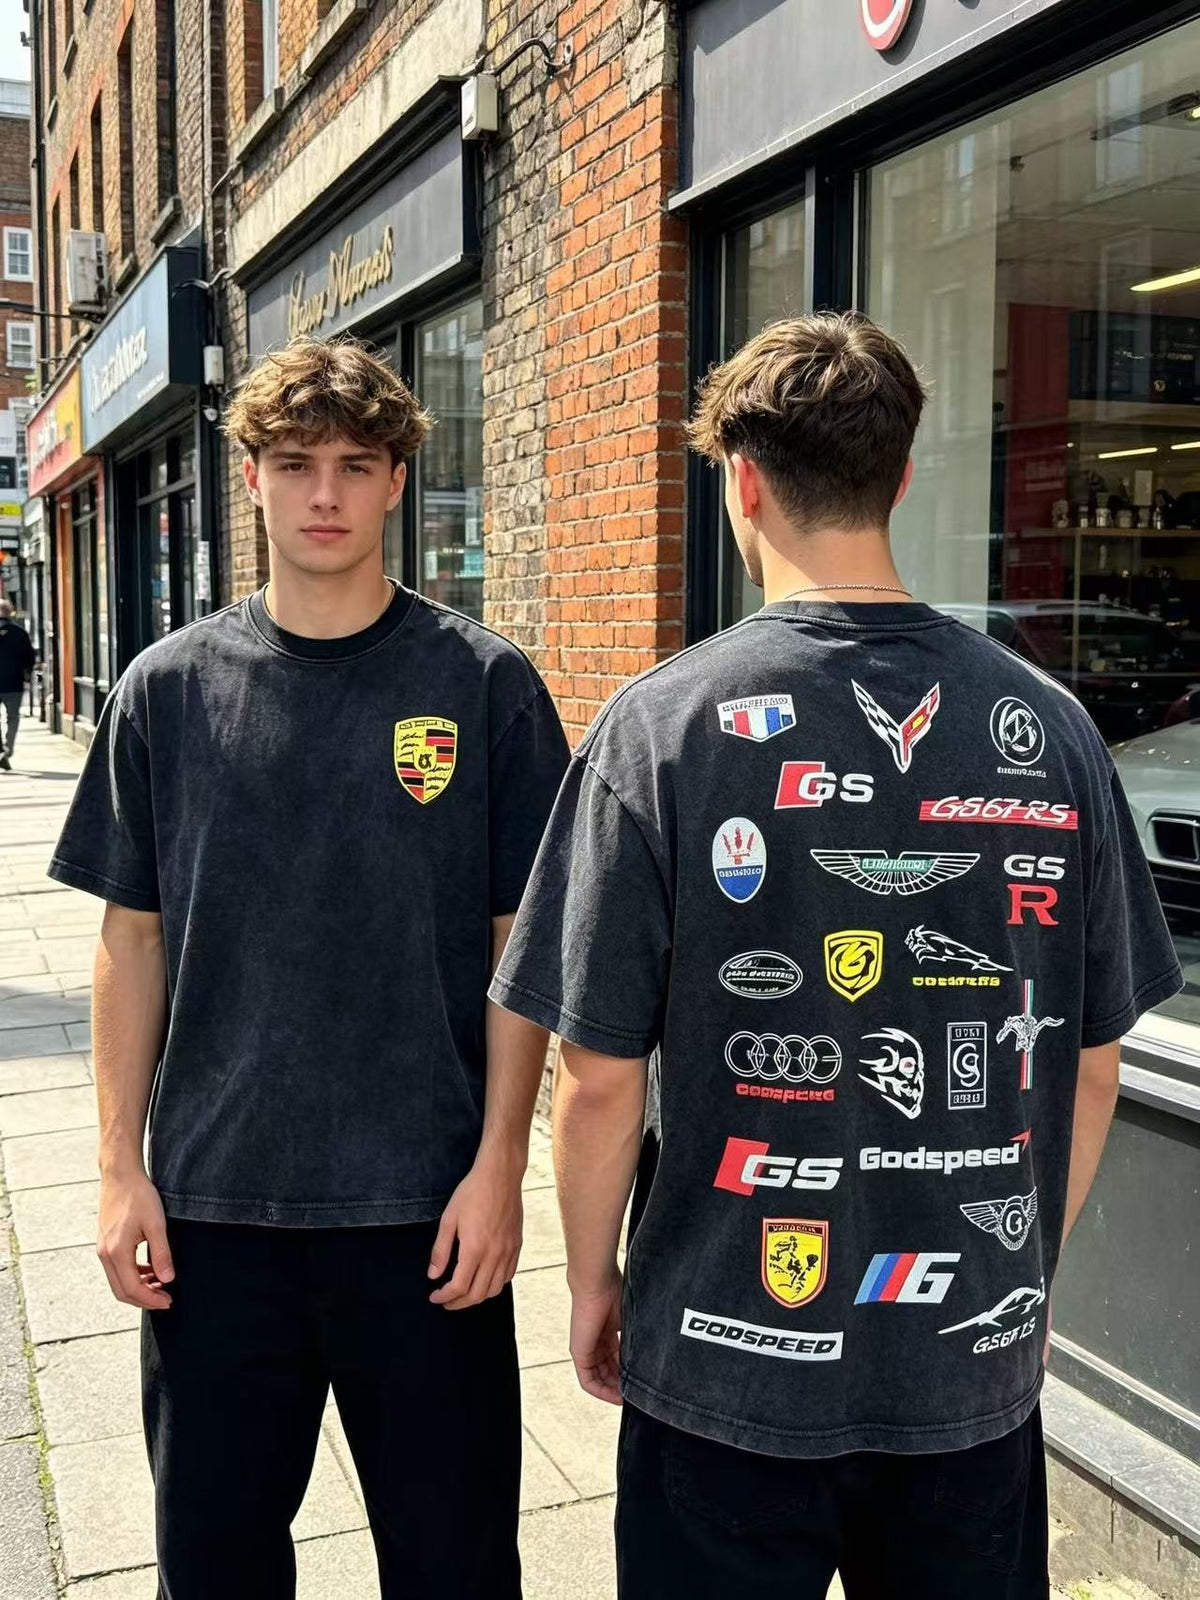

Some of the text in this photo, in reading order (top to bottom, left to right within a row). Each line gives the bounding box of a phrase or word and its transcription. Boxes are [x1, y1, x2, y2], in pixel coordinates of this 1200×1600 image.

[798, 772, 875, 803] GS
[1022, 800, 1071, 824] RS
[1003, 853, 1066, 880] GS
[1006, 883, 1060, 926] R
[741, 1154, 844, 1190] GS
[859, 1142, 1020, 1175] Godspeed
[688, 1316, 837, 1354] GODSPEED
